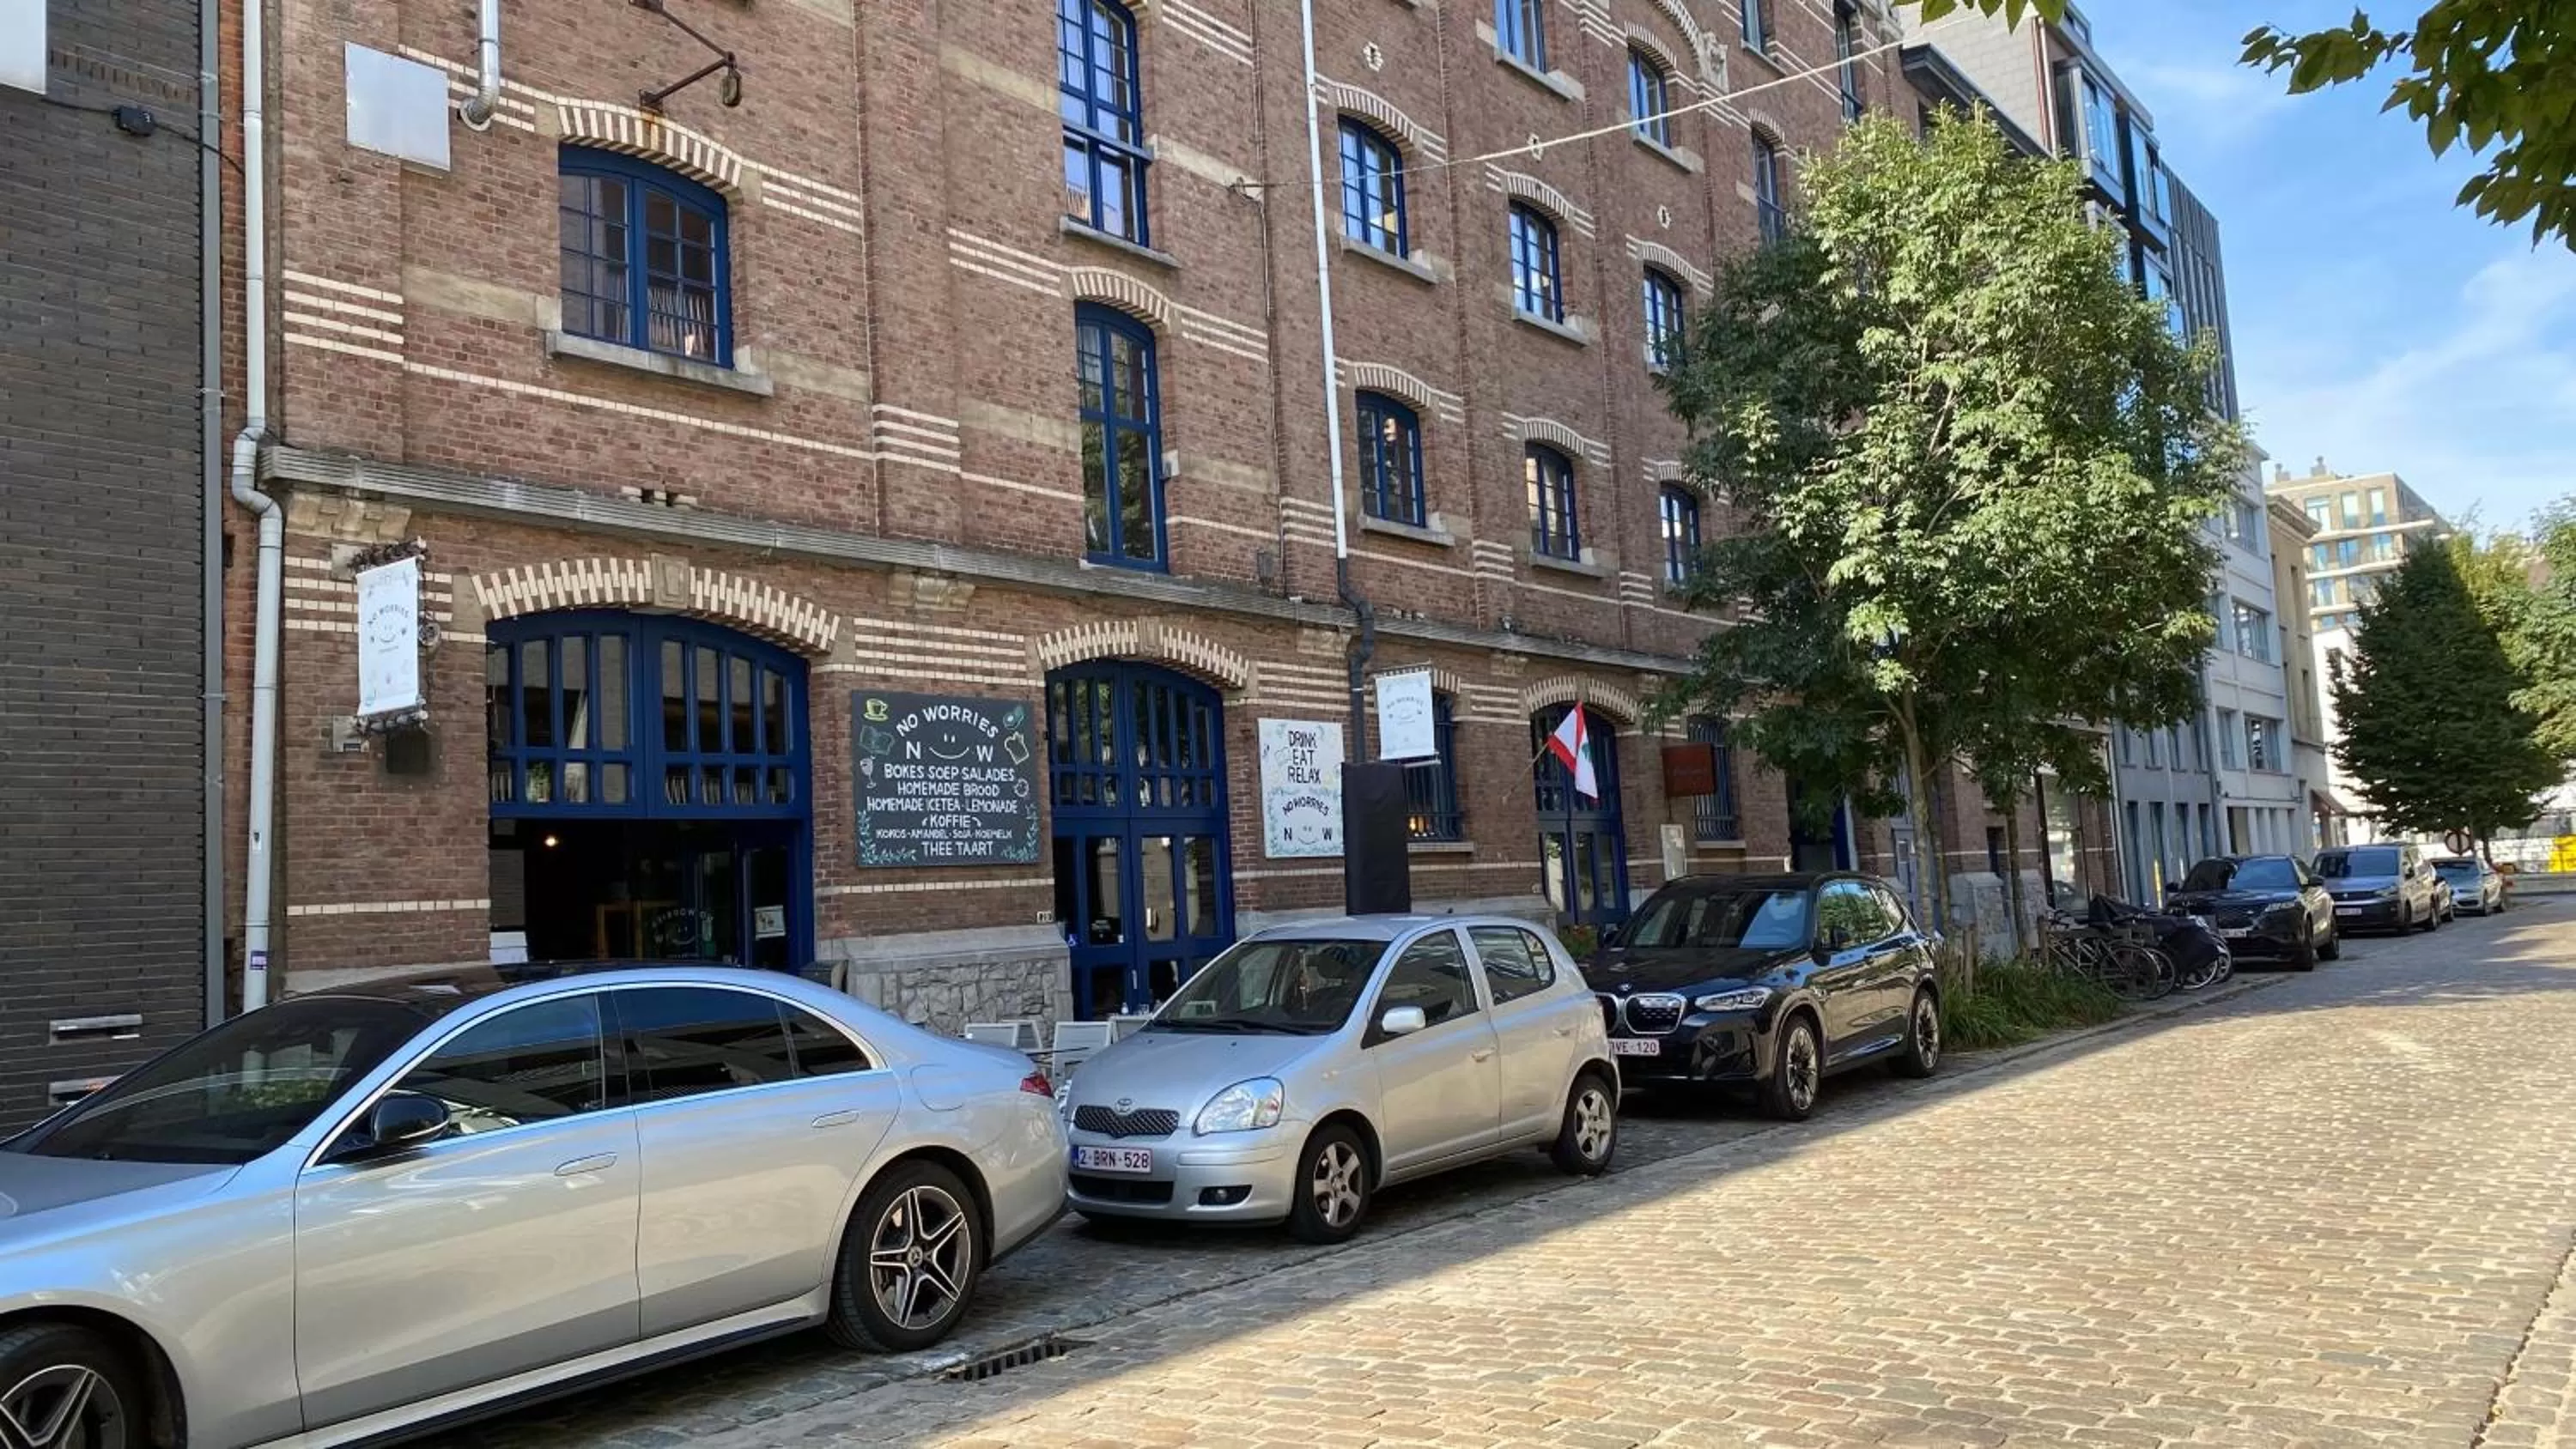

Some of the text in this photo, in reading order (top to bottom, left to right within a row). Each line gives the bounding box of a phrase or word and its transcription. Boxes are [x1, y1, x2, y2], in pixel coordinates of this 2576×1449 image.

[896, 705, 999, 738] NO WORRIES
[1288, 731, 1318, 749] DRINK
[1292, 749, 1315, 767] EAT
[884, 763, 1015, 782] BOKES SOEP SALADES
[1288, 767, 1321, 785] RELAX
[897, 781, 1000, 797] HOMEMADE BROOD
[867, 797, 925, 812] HOMEMADE
[930, 815, 972, 828] KOFFIE
[921, 841, 993, 857] THEE TAART
